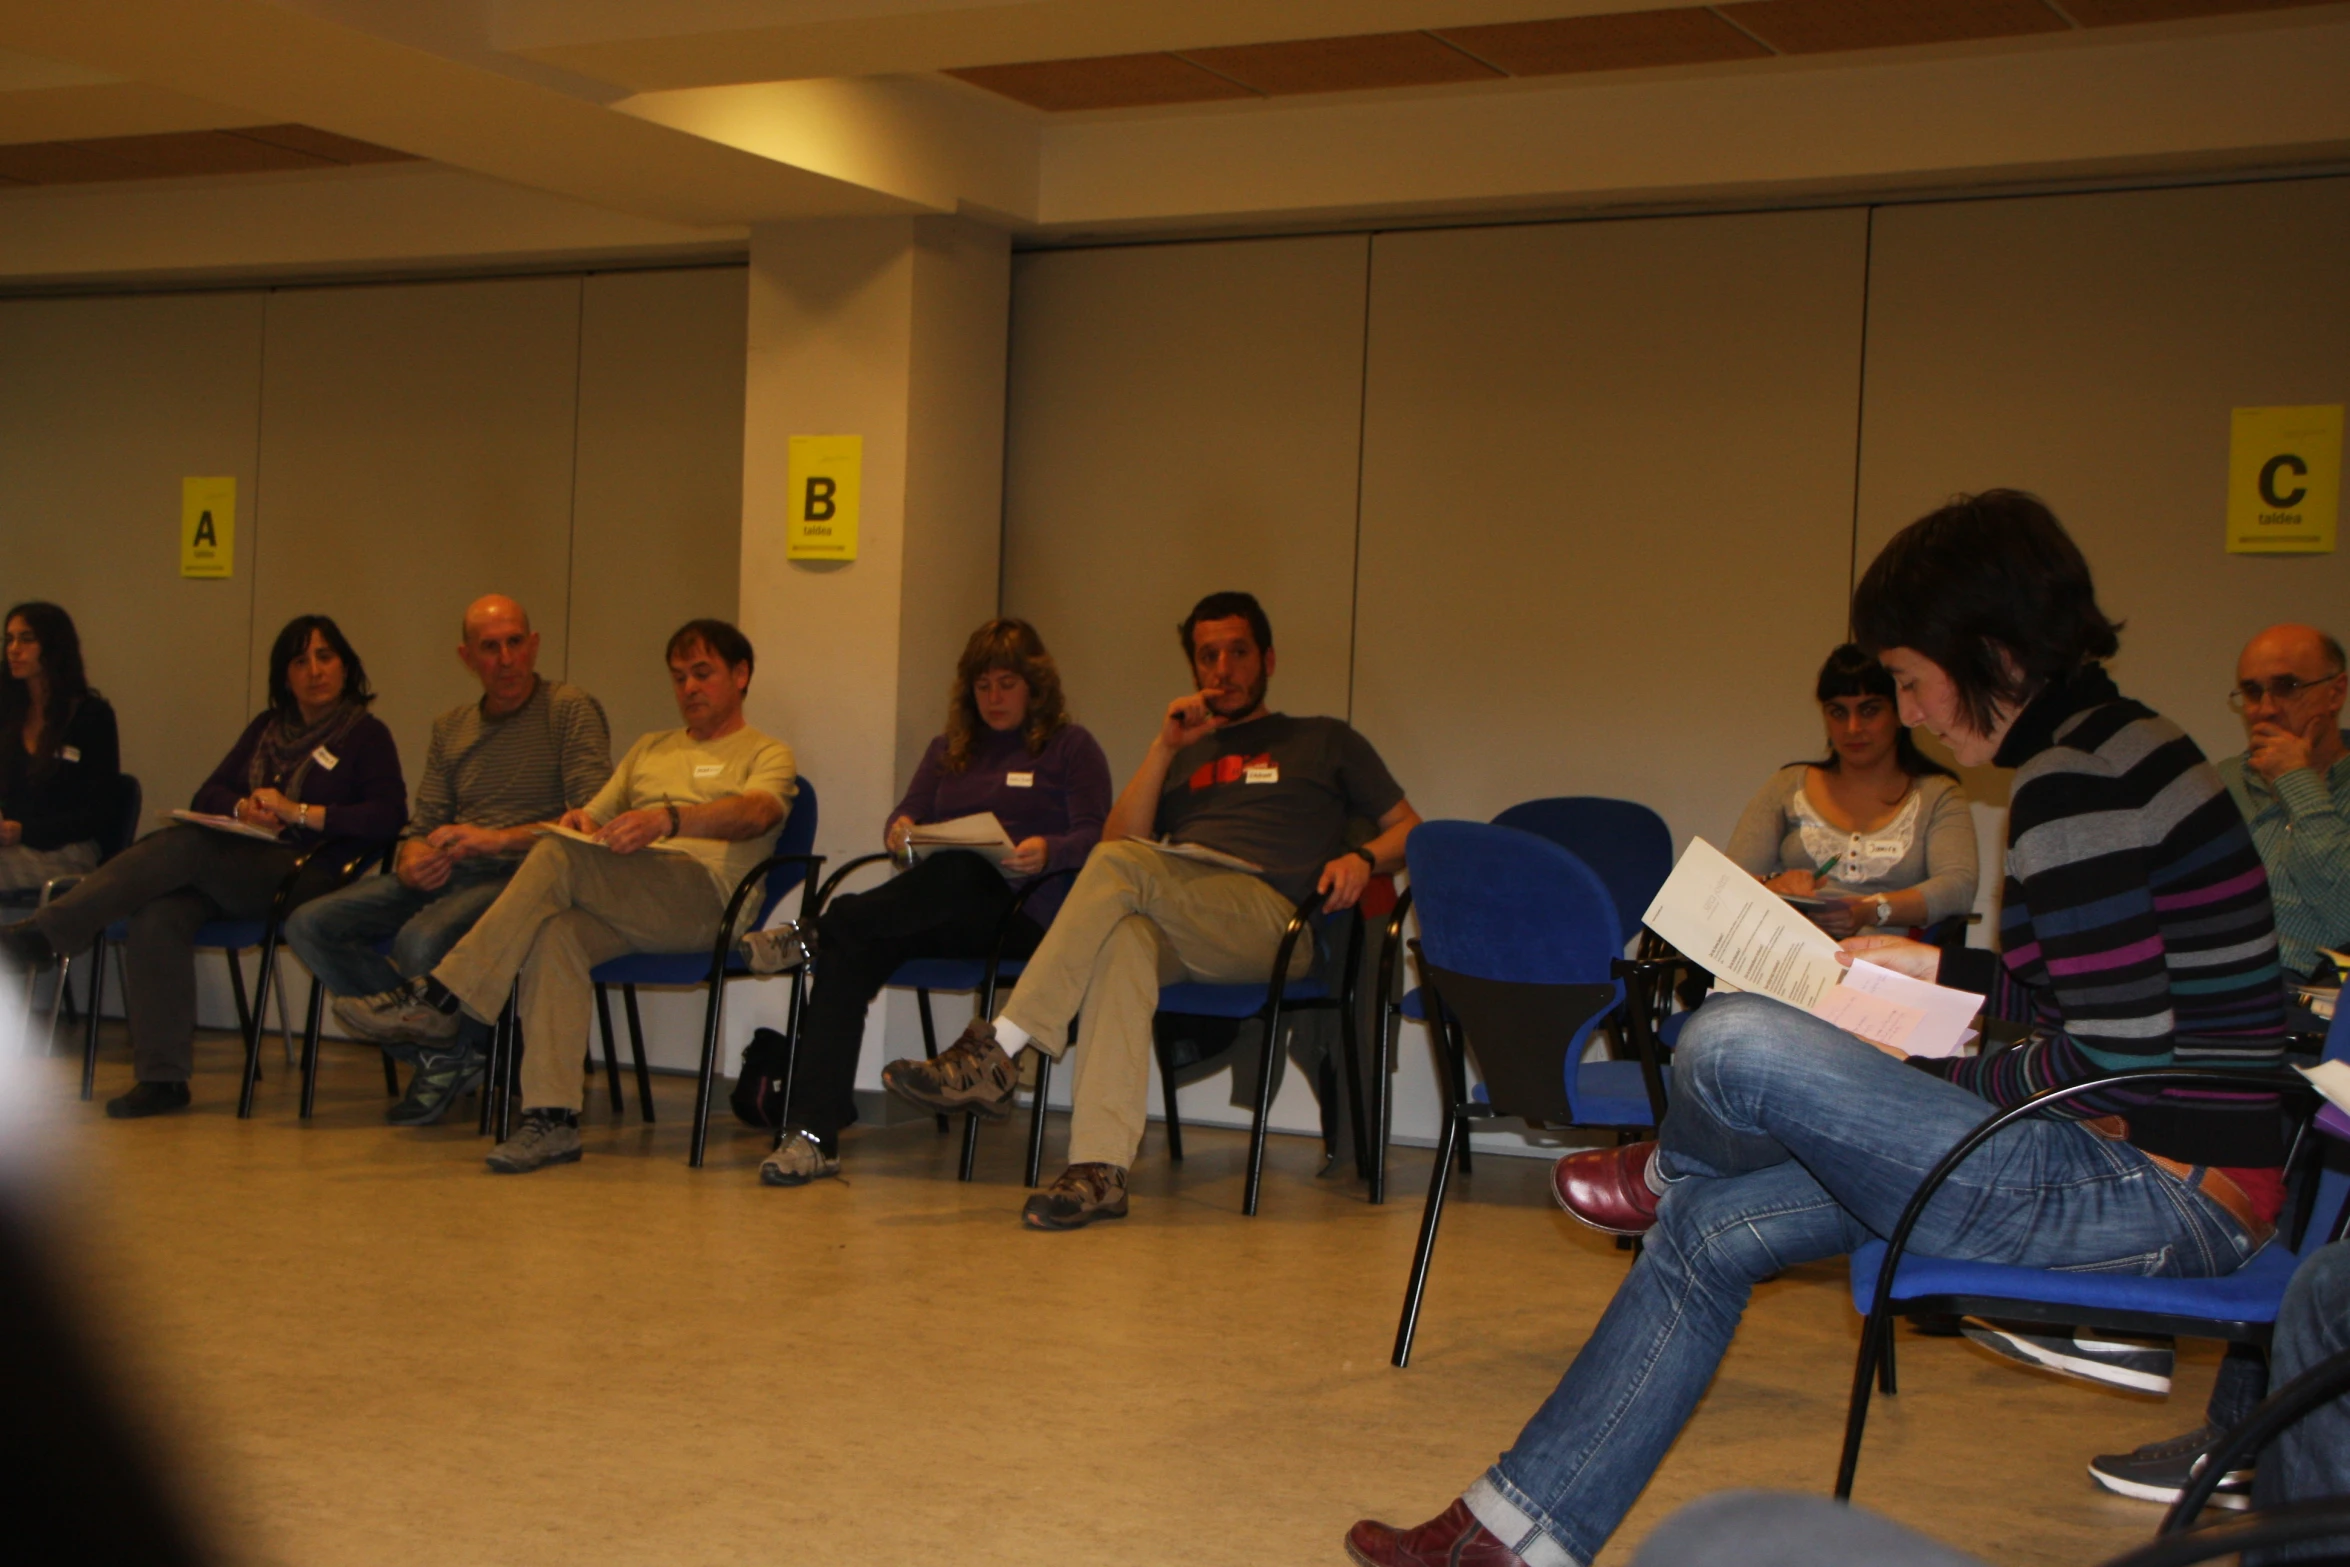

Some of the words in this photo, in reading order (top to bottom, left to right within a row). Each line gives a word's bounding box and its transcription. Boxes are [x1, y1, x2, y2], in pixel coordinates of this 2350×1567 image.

[803, 476, 836, 522] B
[2258, 454, 2308, 509] C
[193, 510, 217, 547] A
